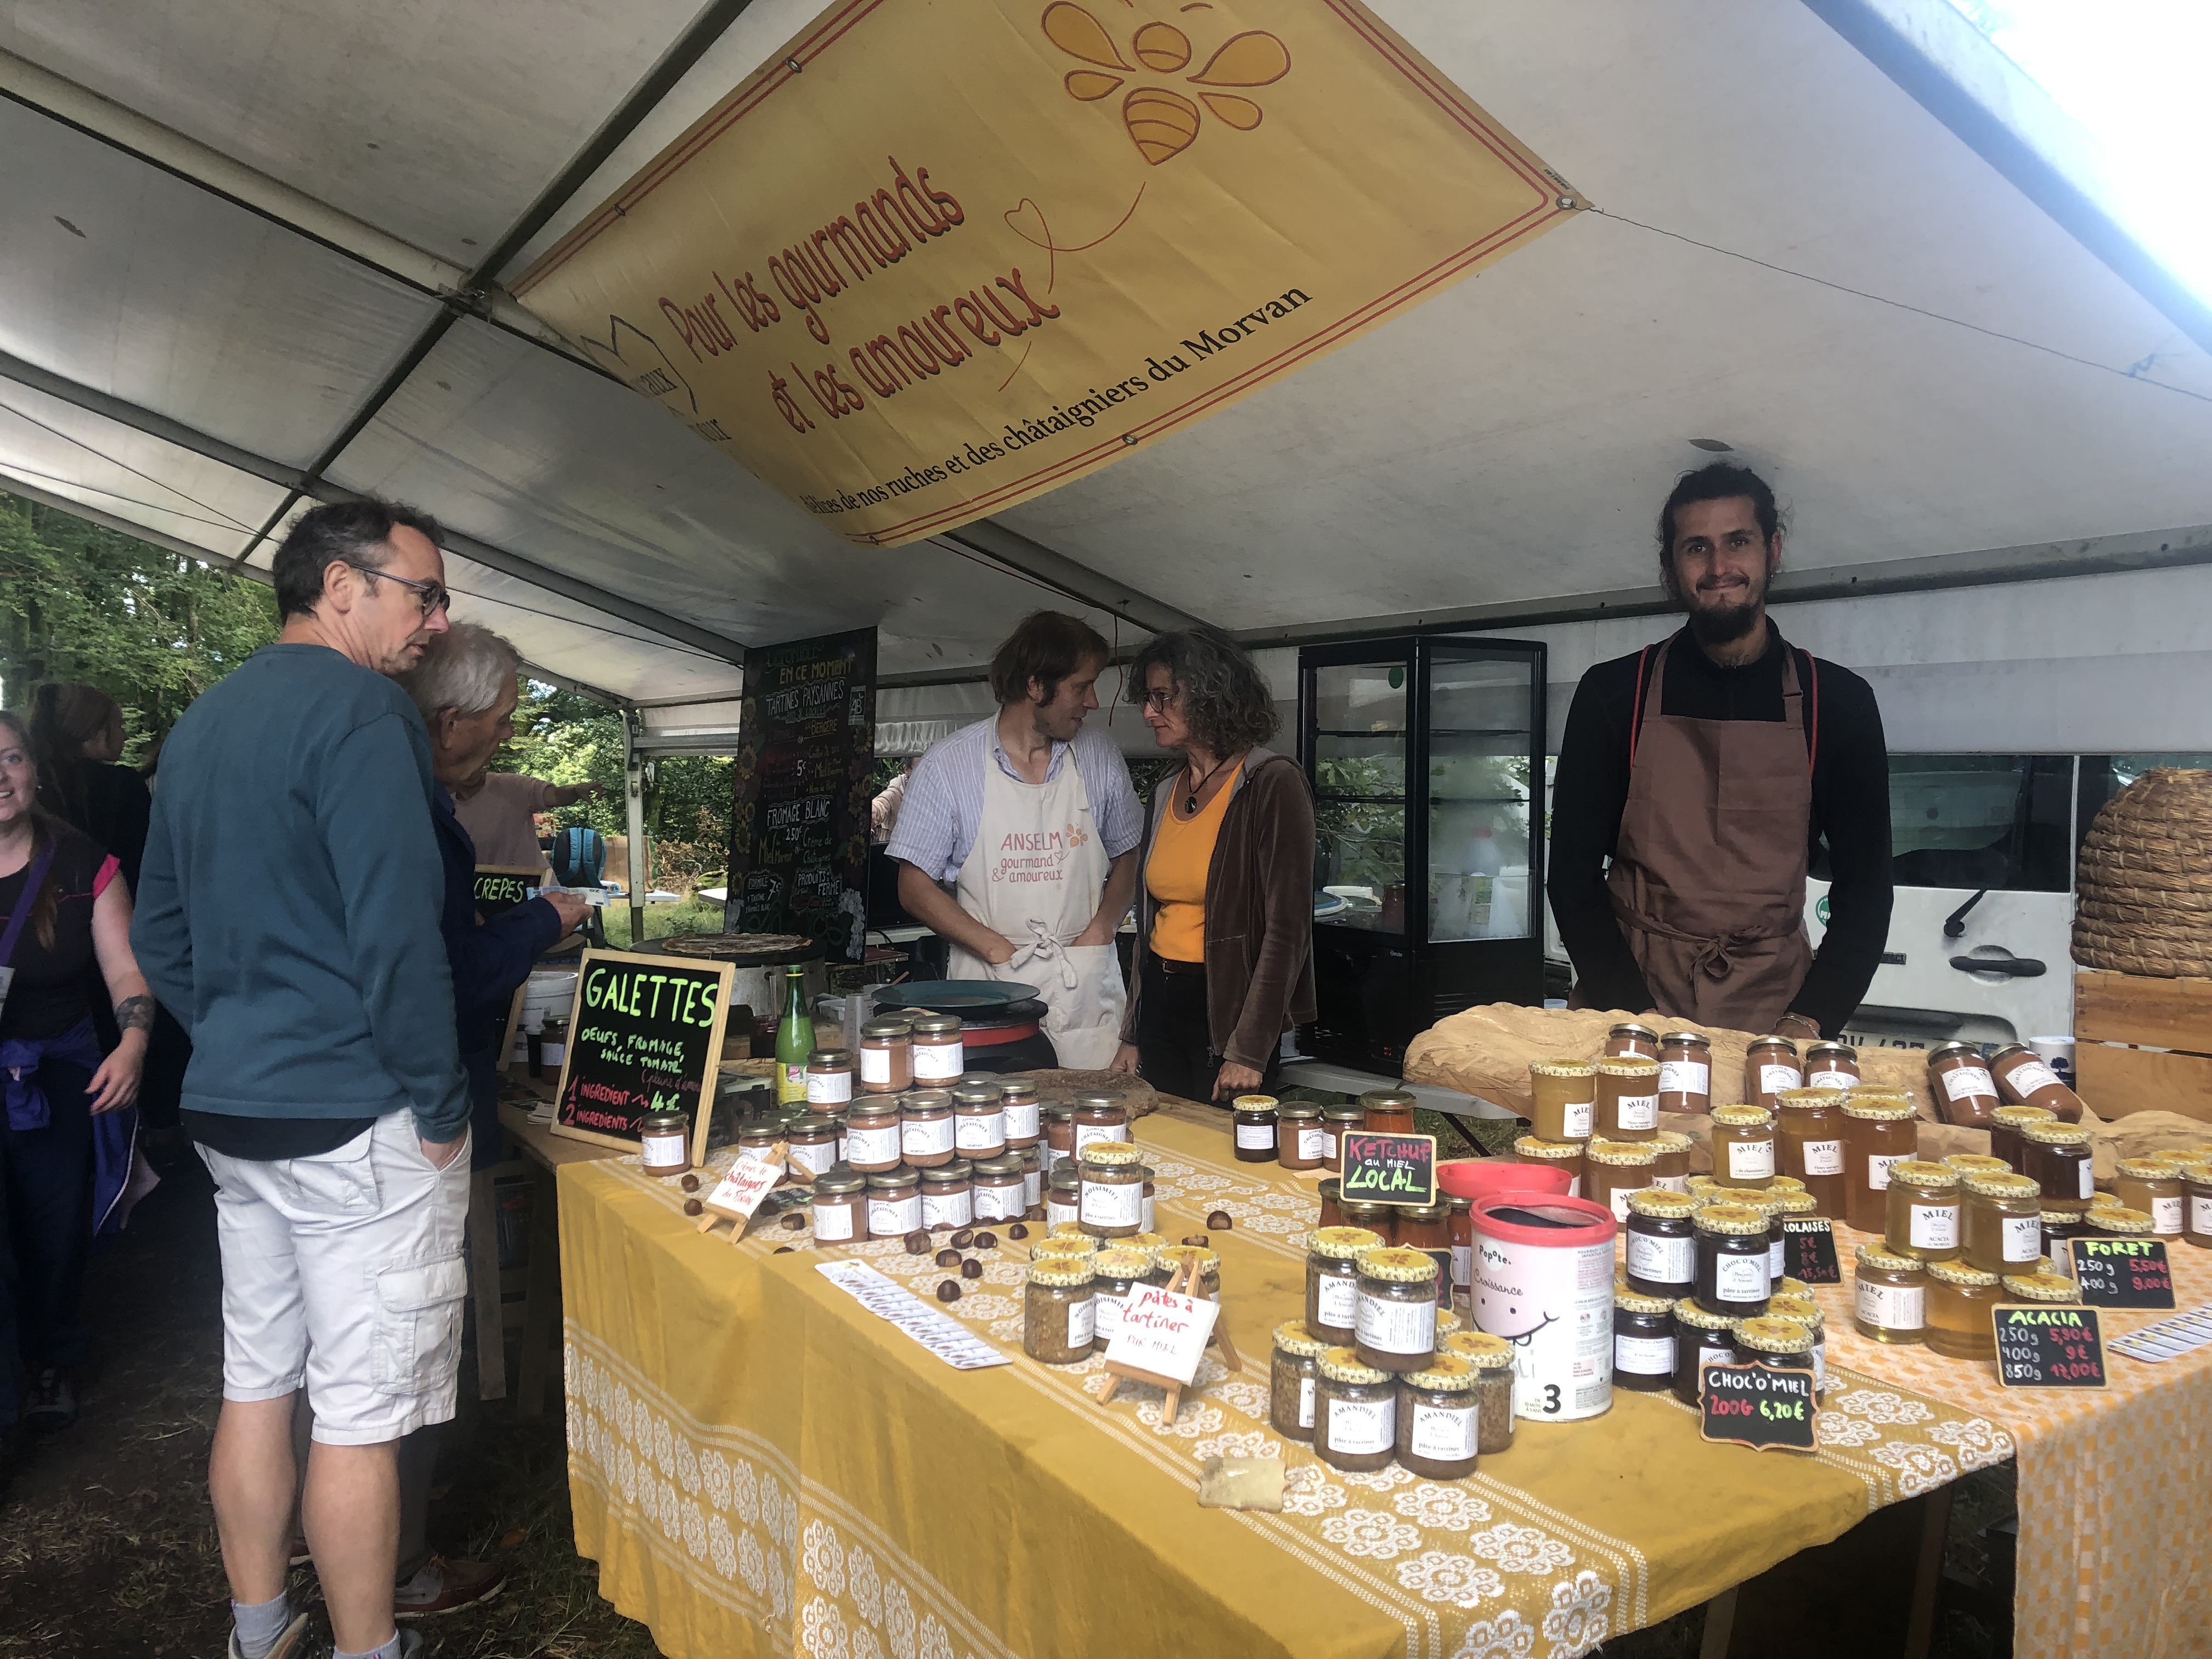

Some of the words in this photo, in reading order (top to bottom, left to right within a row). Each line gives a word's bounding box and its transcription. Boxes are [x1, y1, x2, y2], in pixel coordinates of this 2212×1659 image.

[659, 292, 738, 364] Pour
[712, 271, 780, 331] les
[768, 155, 964, 345] gourmands
[849, 268, 1060, 398] amoureux
[791, 362, 865, 419] les
[836, 489, 861, 510] de
[857, 483, 889, 507] nos
[885, 466, 948, 498] ruches
[945, 454, 970, 474] et
[963, 441, 1006, 466] des
[1003, 374, 1149, 450] châtaigniers
[1144, 357, 1191, 382] du
[1180, 287, 1313, 362] Morvan
[768, 369, 815, 433] et
[780, 668, 793, 684] EN
[795, 664, 807, 680] CE
[811, 658, 854, 679] MOMENT
[766, 689, 799, 715] TARTINES
[803, 680, 845, 707] PAYSANNES
[766, 804, 800, 827] FROMAGE
[805, 799, 831, 820] BLANC
[1001, 832, 1063, 851] ANSELM
[1001, 854, 1053, 874] gourmand
[992, 868, 1004, 882] &
[1009, 870, 1063, 883] amoureux
[474, 877, 524, 902] CREPES
[818, 880, 840, 896] FERME
[586, 968, 718, 1028] GALETTES
[600, 1049, 633, 1065] SAUCE
[568, 1074, 578, 1102] 1
[563, 1103, 575, 1125] 2
[1627, 1100, 1651, 1109] MIEL
[1348, 1136, 1432, 1164] KETCHUP
[1736, 1144, 1763, 1154] MIEL
[1812, 1144, 1838, 1154] MIEL
[1364, 1159, 1380, 1167] au
[1387, 1159, 1416, 1171] MIEL
[1346, 1165, 1427, 1194] LOCAL
[1922, 1209, 1954, 1221] MIEL
[1784, 1221, 1831, 1233] ROLAISES
[2085, 1242, 2154, 1257] FORET
[1324, 1280, 1356, 1293] AMAND
[1474, 1268, 1523, 1296] Croissance
[1858, 1283, 1884, 1300] MIEL
[1184, 1299, 1193, 1313] à
[1122, 1302, 1189, 1333] tartiner
[2008, 1311, 2083, 1327] ACACIA
[1999, 1327, 2039, 1346] 250g
[2002, 1346, 2041, 1363] 400g
[2006, 1363, 2042, 1381] 850g
[1708, 1371, 1809, 1397] CHOC'O'MIEL
[1543, 1384, 1561, 1414] 3
[1710, 1393, 1755, 1416] 200G
[1759, 1400, 1805, 1422] 6,20€
[1334, 1404, 1376, 1420] AMANDIEL
[1420, 1411, 1463, 1427] AMANDIEL
